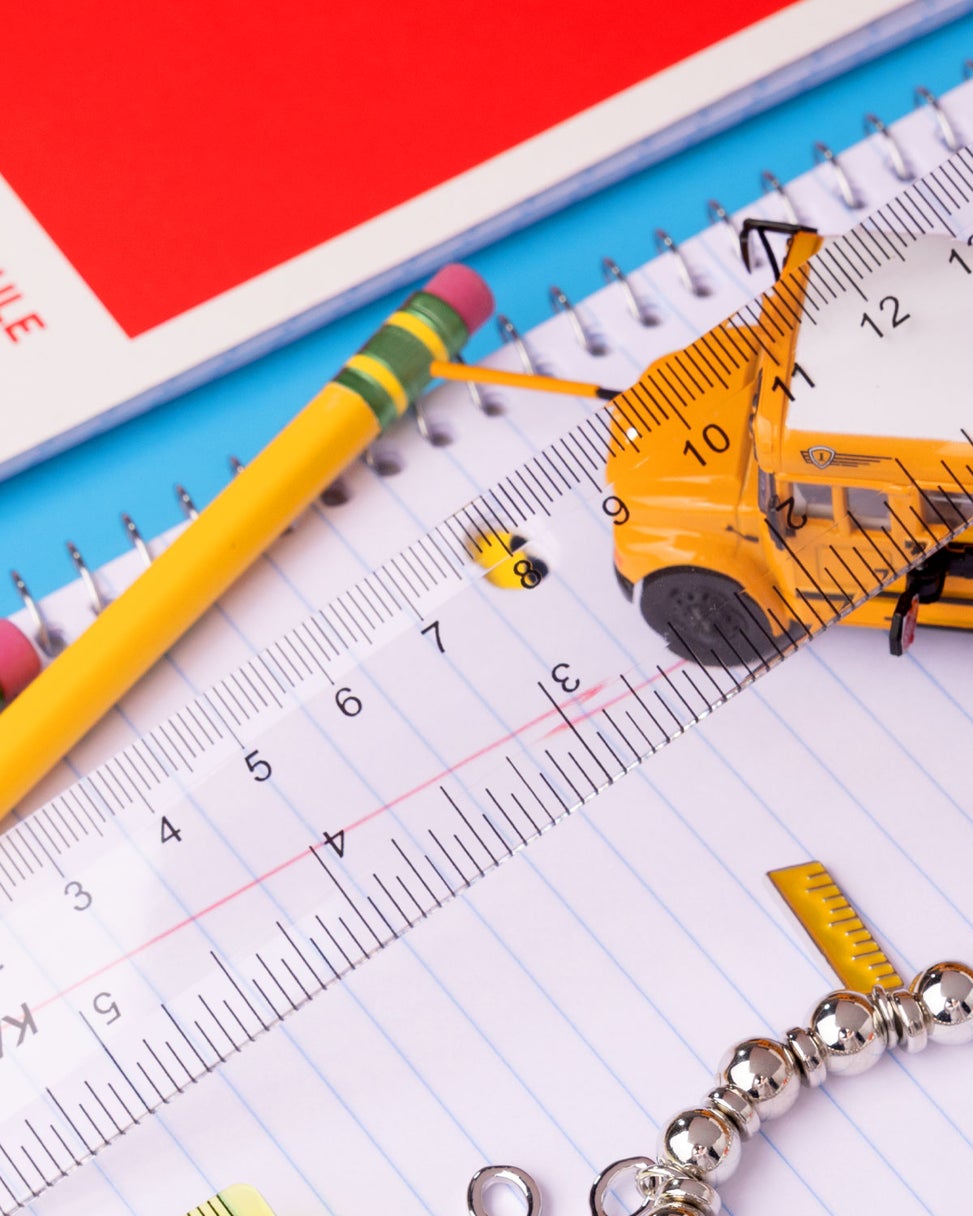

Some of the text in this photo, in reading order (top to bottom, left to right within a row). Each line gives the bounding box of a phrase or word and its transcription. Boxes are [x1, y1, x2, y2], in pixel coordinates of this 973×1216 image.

[775, 497, 808, 530] 2
[64, 881, 92, 911] 3
[161, 816, 182, 843] 4
[244, 749, 272, 782] 5
[335, 687, 362, 717] 6
[421, 620, 445, 653] 7
[513, 559, 542, 589] 8
[602, 496, 630, 526] 9
[683, 423, 730, 466] 10
[772, 363, 815, 402] 11
[860, 296, 911, 338] 12
[551, 663, 580, 693] 3
[322, 829, 345, 858] 4
[92, 992, 121, 1025] 5
